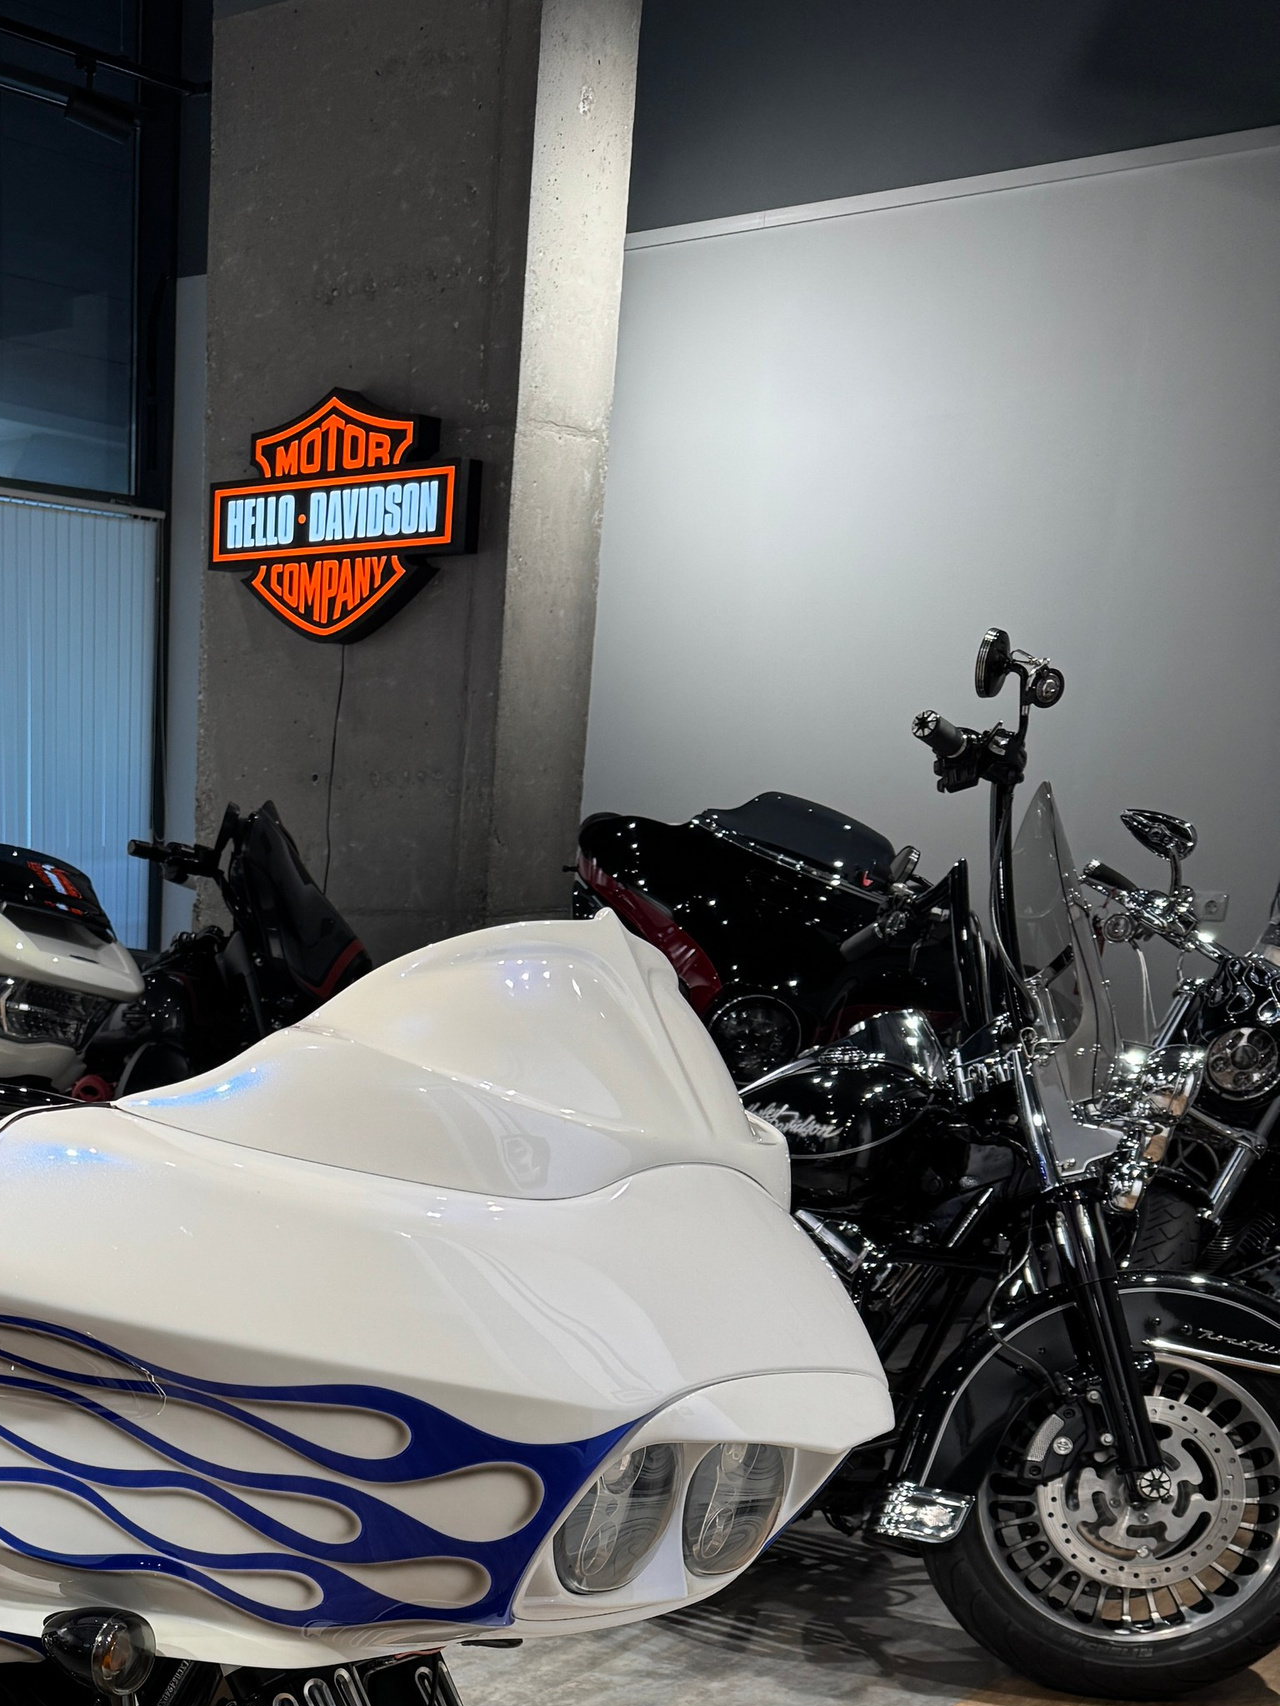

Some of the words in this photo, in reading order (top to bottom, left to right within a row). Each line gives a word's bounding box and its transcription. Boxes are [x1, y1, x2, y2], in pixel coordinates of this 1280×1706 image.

[276, 414, 391, 477] MOTOR
[227, 495, 295, 549] HELLO
[309, 480, 439, 542] DAVIDSON
[270, 556, 388, 624] COMPANY
